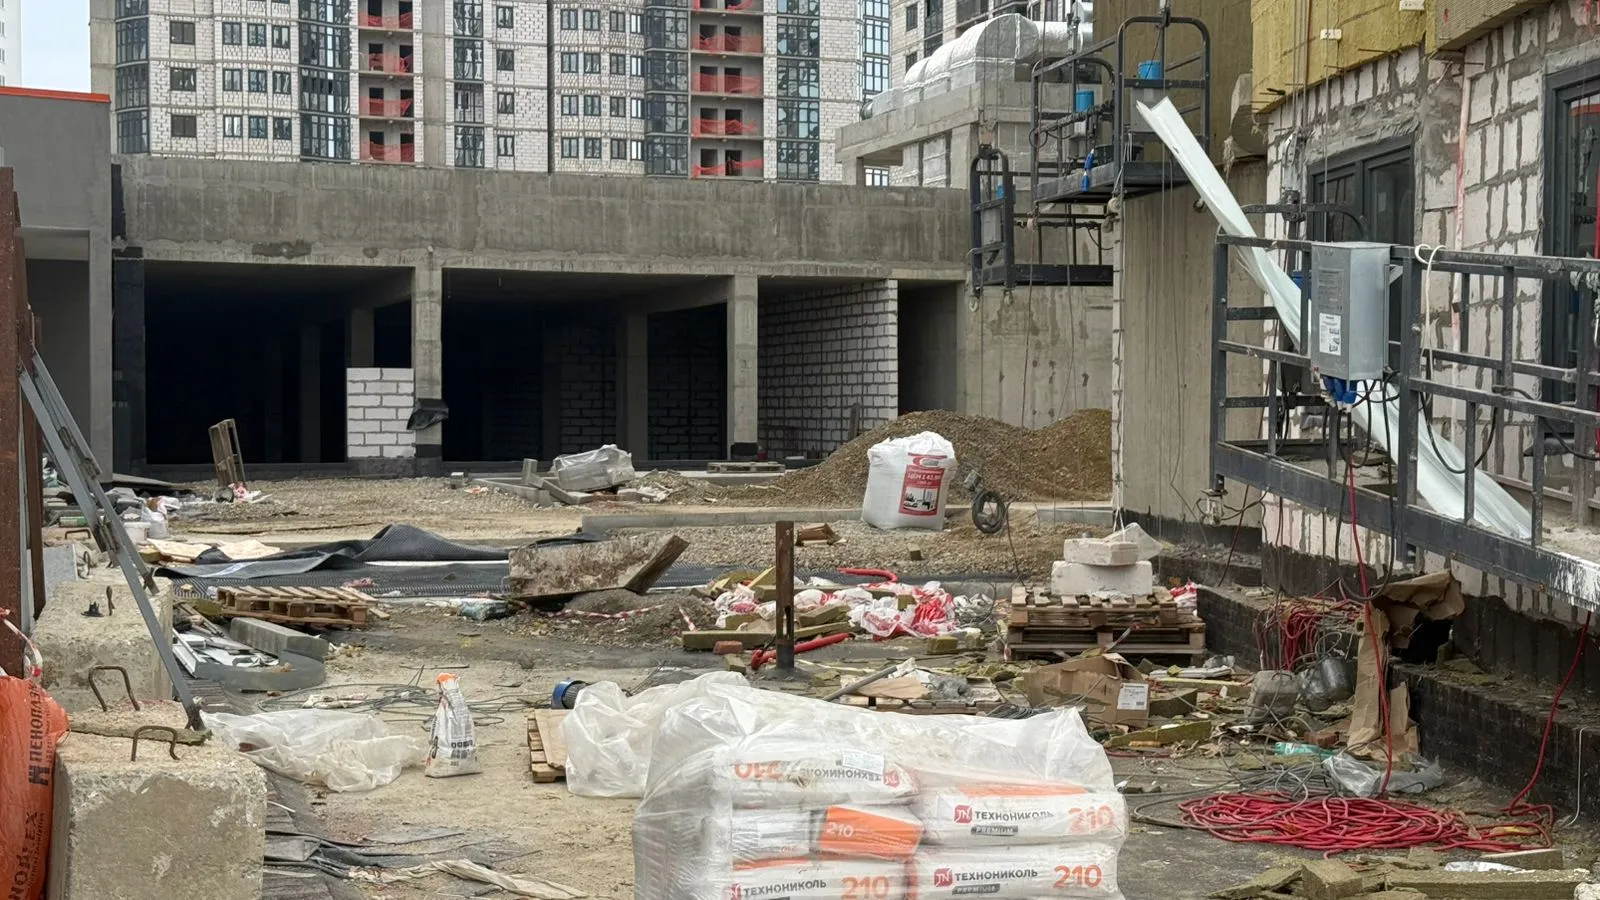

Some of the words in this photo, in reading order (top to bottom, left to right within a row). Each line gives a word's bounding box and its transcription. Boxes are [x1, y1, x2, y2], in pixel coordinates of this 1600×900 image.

[826, 821, 854, 837] 210
[1067, 805, 1115, 832] 210
[743, 879, 827, 897] ТЕХНОНИКОЛЬ
[840, 875, 889, 900] 210
[955, 868, 1038, 881] ТЕХНОНИКОЛЬ
[1053, 864, 1103, 888] 210
